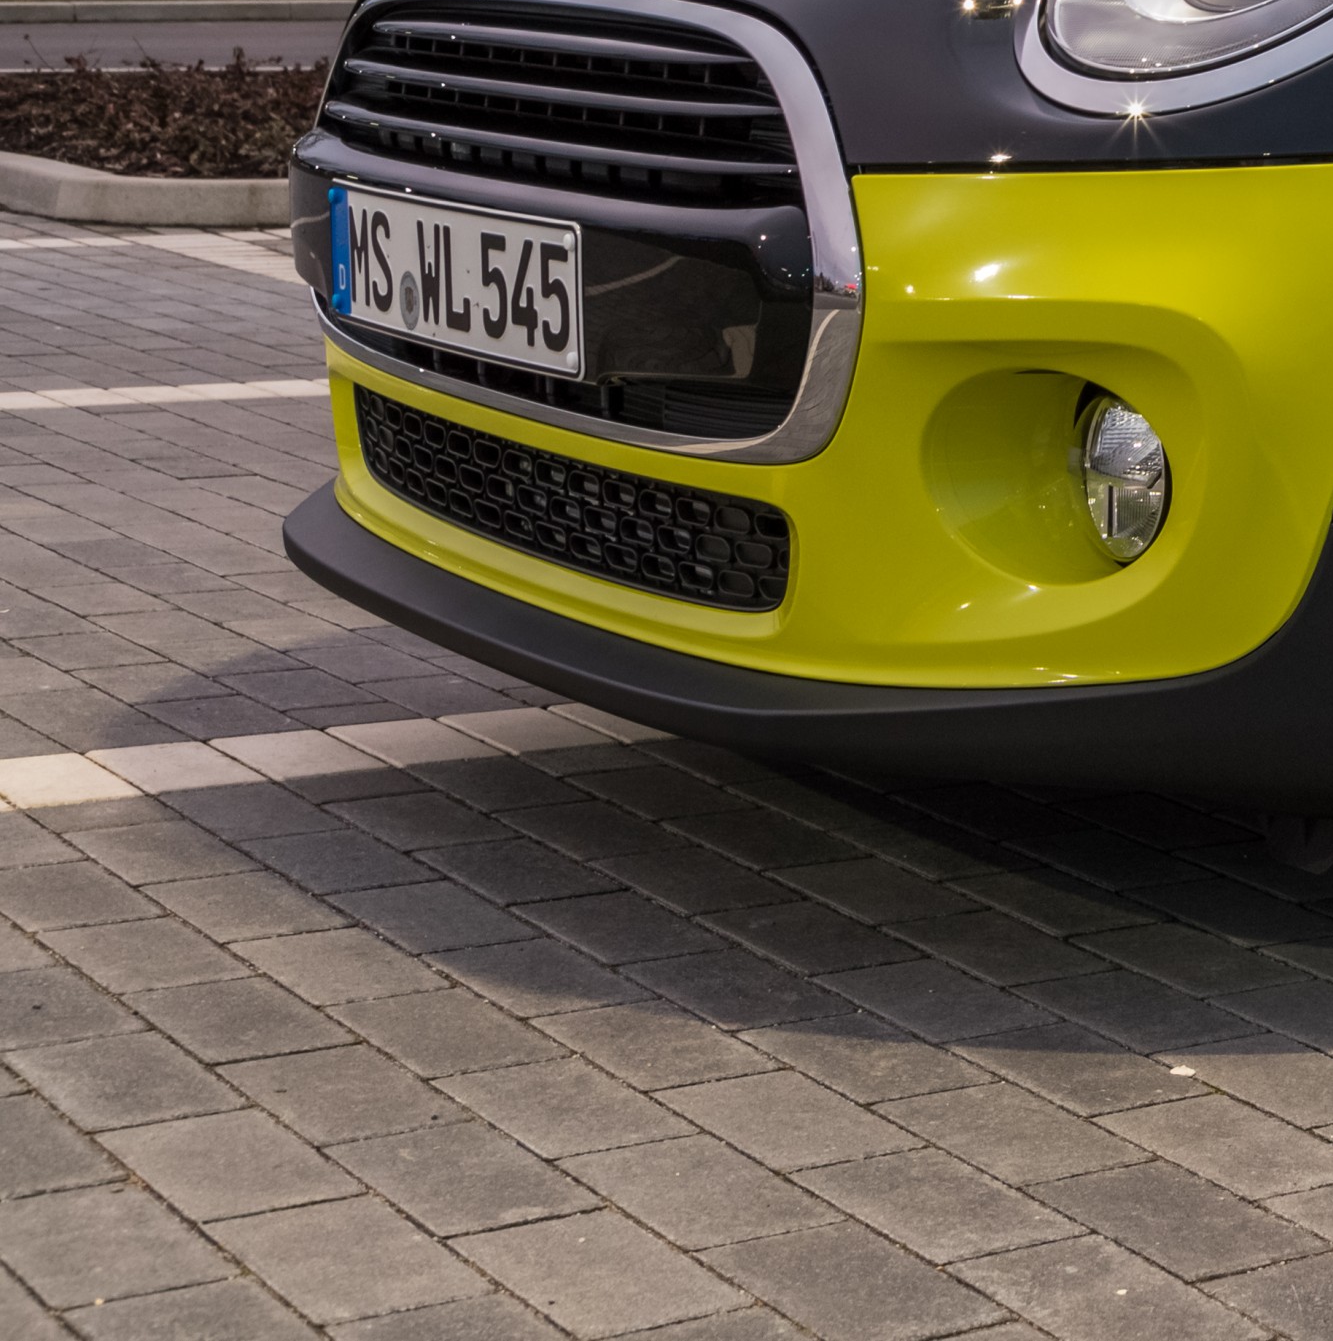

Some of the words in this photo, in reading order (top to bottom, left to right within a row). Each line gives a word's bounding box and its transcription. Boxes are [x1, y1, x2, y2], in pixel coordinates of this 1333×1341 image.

[339, 263, 348, 290] D
[349, 205, 394, 312] MS
[416, 219, 471, 333] WL
[480, 231, 570, 351] 545
